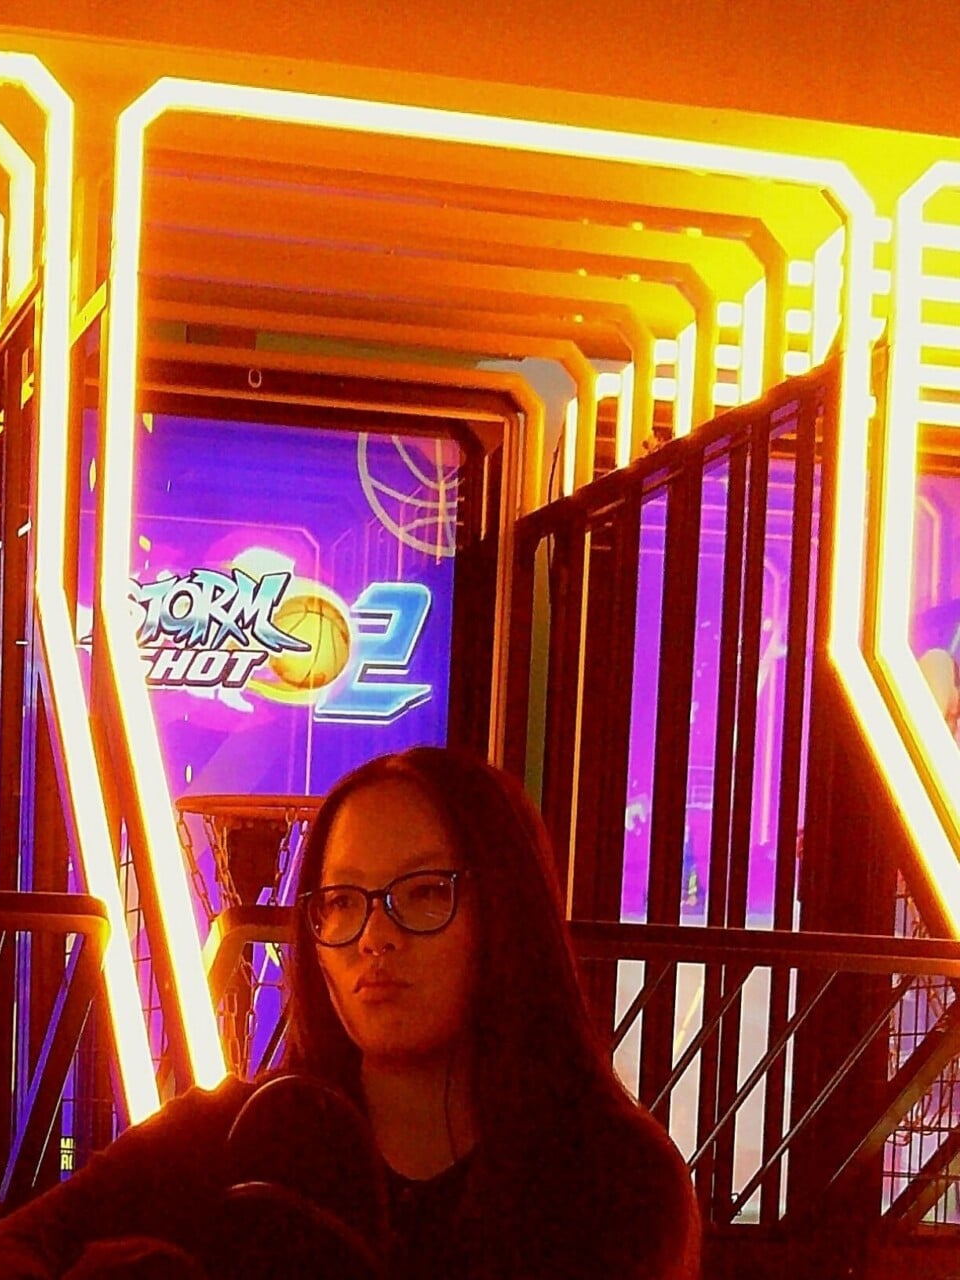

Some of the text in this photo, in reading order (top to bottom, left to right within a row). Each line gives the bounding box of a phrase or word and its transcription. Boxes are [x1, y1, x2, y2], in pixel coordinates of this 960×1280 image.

[127, 568, 312, 653] TORM
[140, 647, 269, 689] HOT
[313, 581, 433, 726] 2
